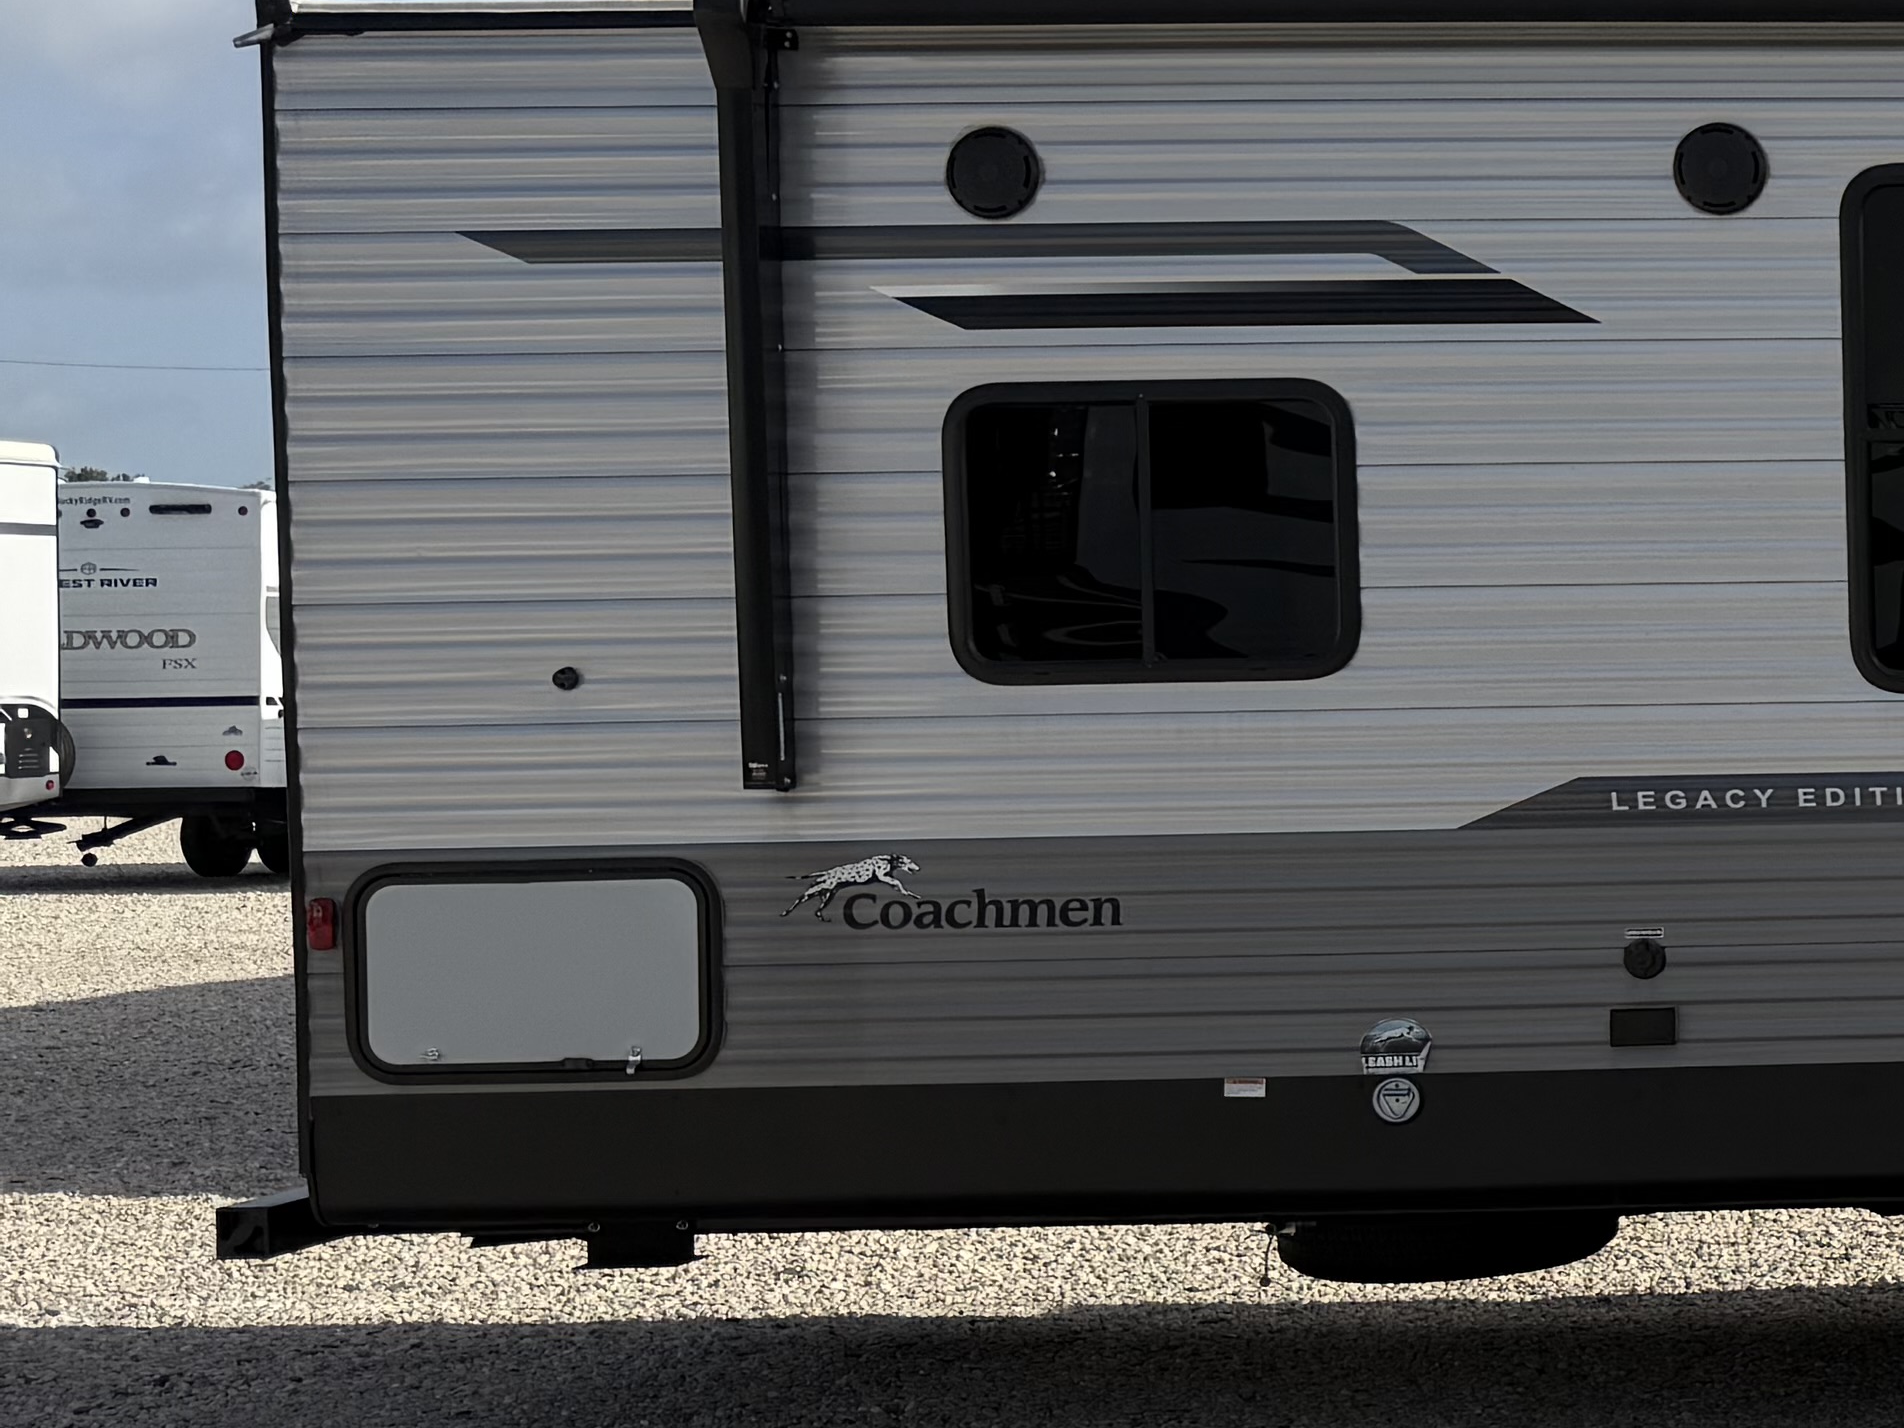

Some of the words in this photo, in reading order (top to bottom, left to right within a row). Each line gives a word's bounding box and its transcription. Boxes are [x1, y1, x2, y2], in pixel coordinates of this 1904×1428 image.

[59, 578, 95, 588] EST
[100, 577, 158, 587] RIVER
[61, 628, 197, 651] DWOOD
[162, 657, 198, 670] FSX
[1611, 788, 1774, 811] LEGACY
[843, 887, 1124, 930] Coachmen
